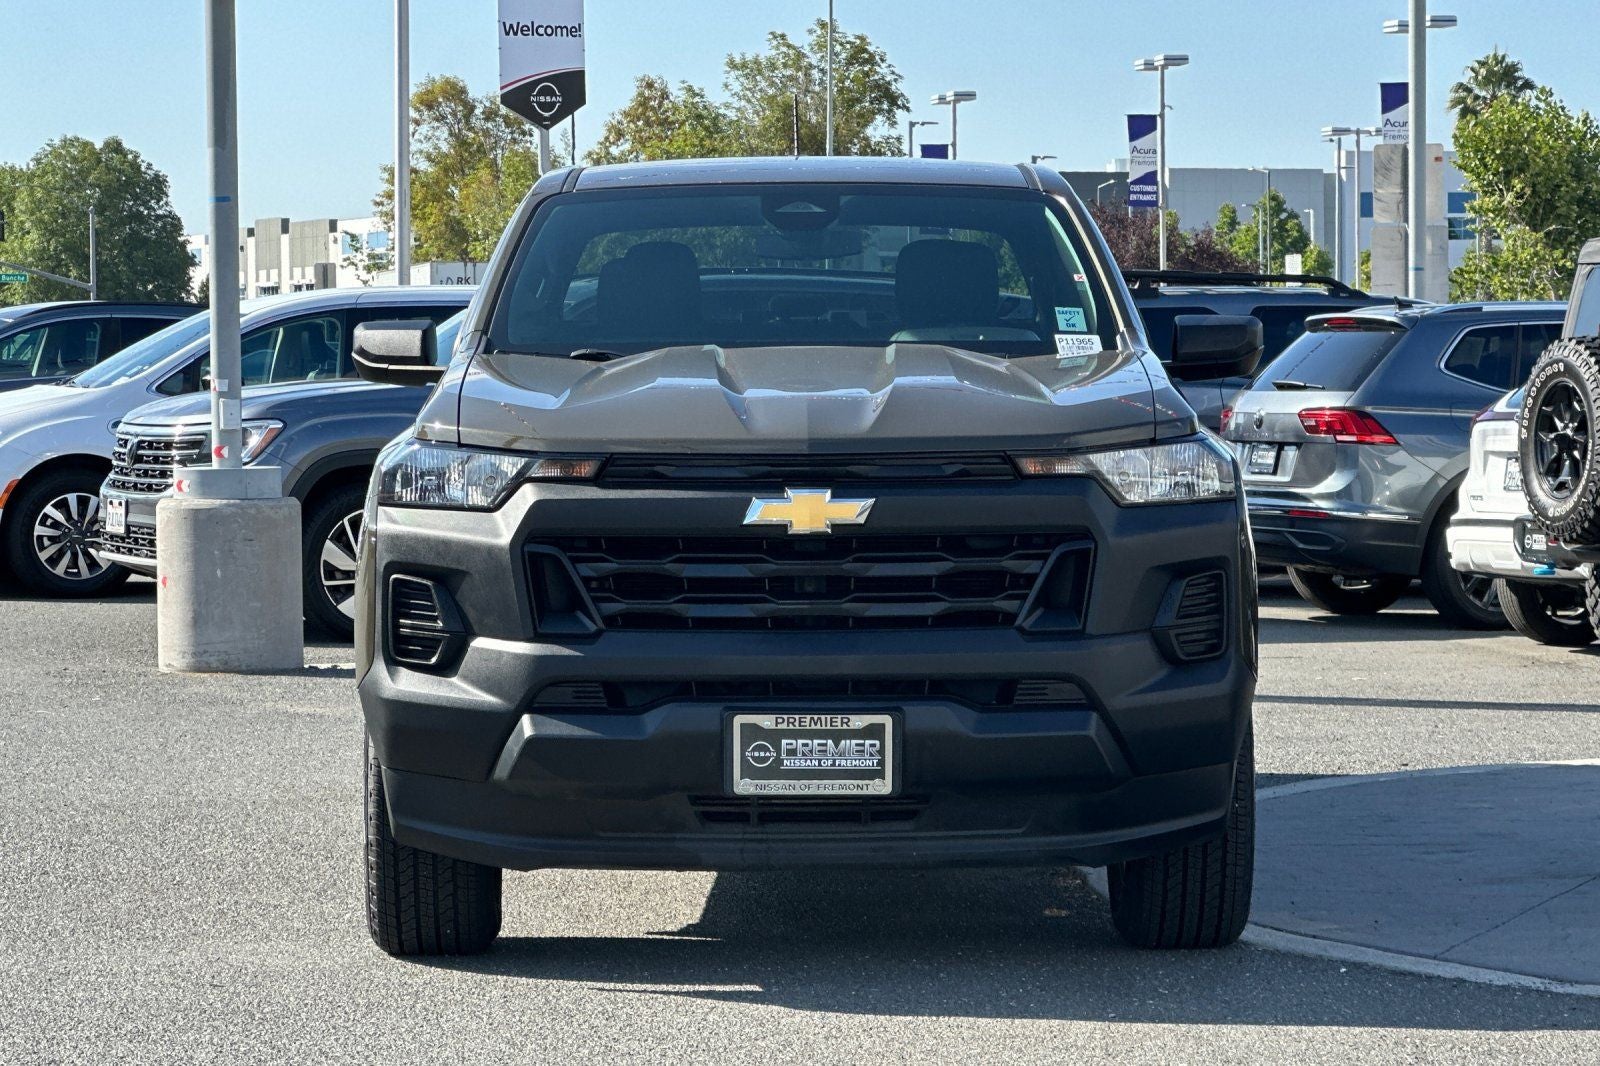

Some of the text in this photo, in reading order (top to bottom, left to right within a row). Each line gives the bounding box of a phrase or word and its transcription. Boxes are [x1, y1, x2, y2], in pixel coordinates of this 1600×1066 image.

[502, 21, 582, 38] Welcome!
[1383, 118, 1409, 128] Acur
[1131, 145, 1157, 155] Acura
[1130, 158, 1157, 166] Fremont
[1129, 184, 1157, 192] CUSTOMER
[1129, 193, 1157, 201] ENTRANCE
[1057, 337, 1094, 346] P11965
[774, 716, 851, 728] PREMIER
[781, 738, 881, 758] PREMIER
[783, 759, 878, 767] NISSAN OF FREMONT
[755, 783, 871, 792] NISSAN OF FREMONT
